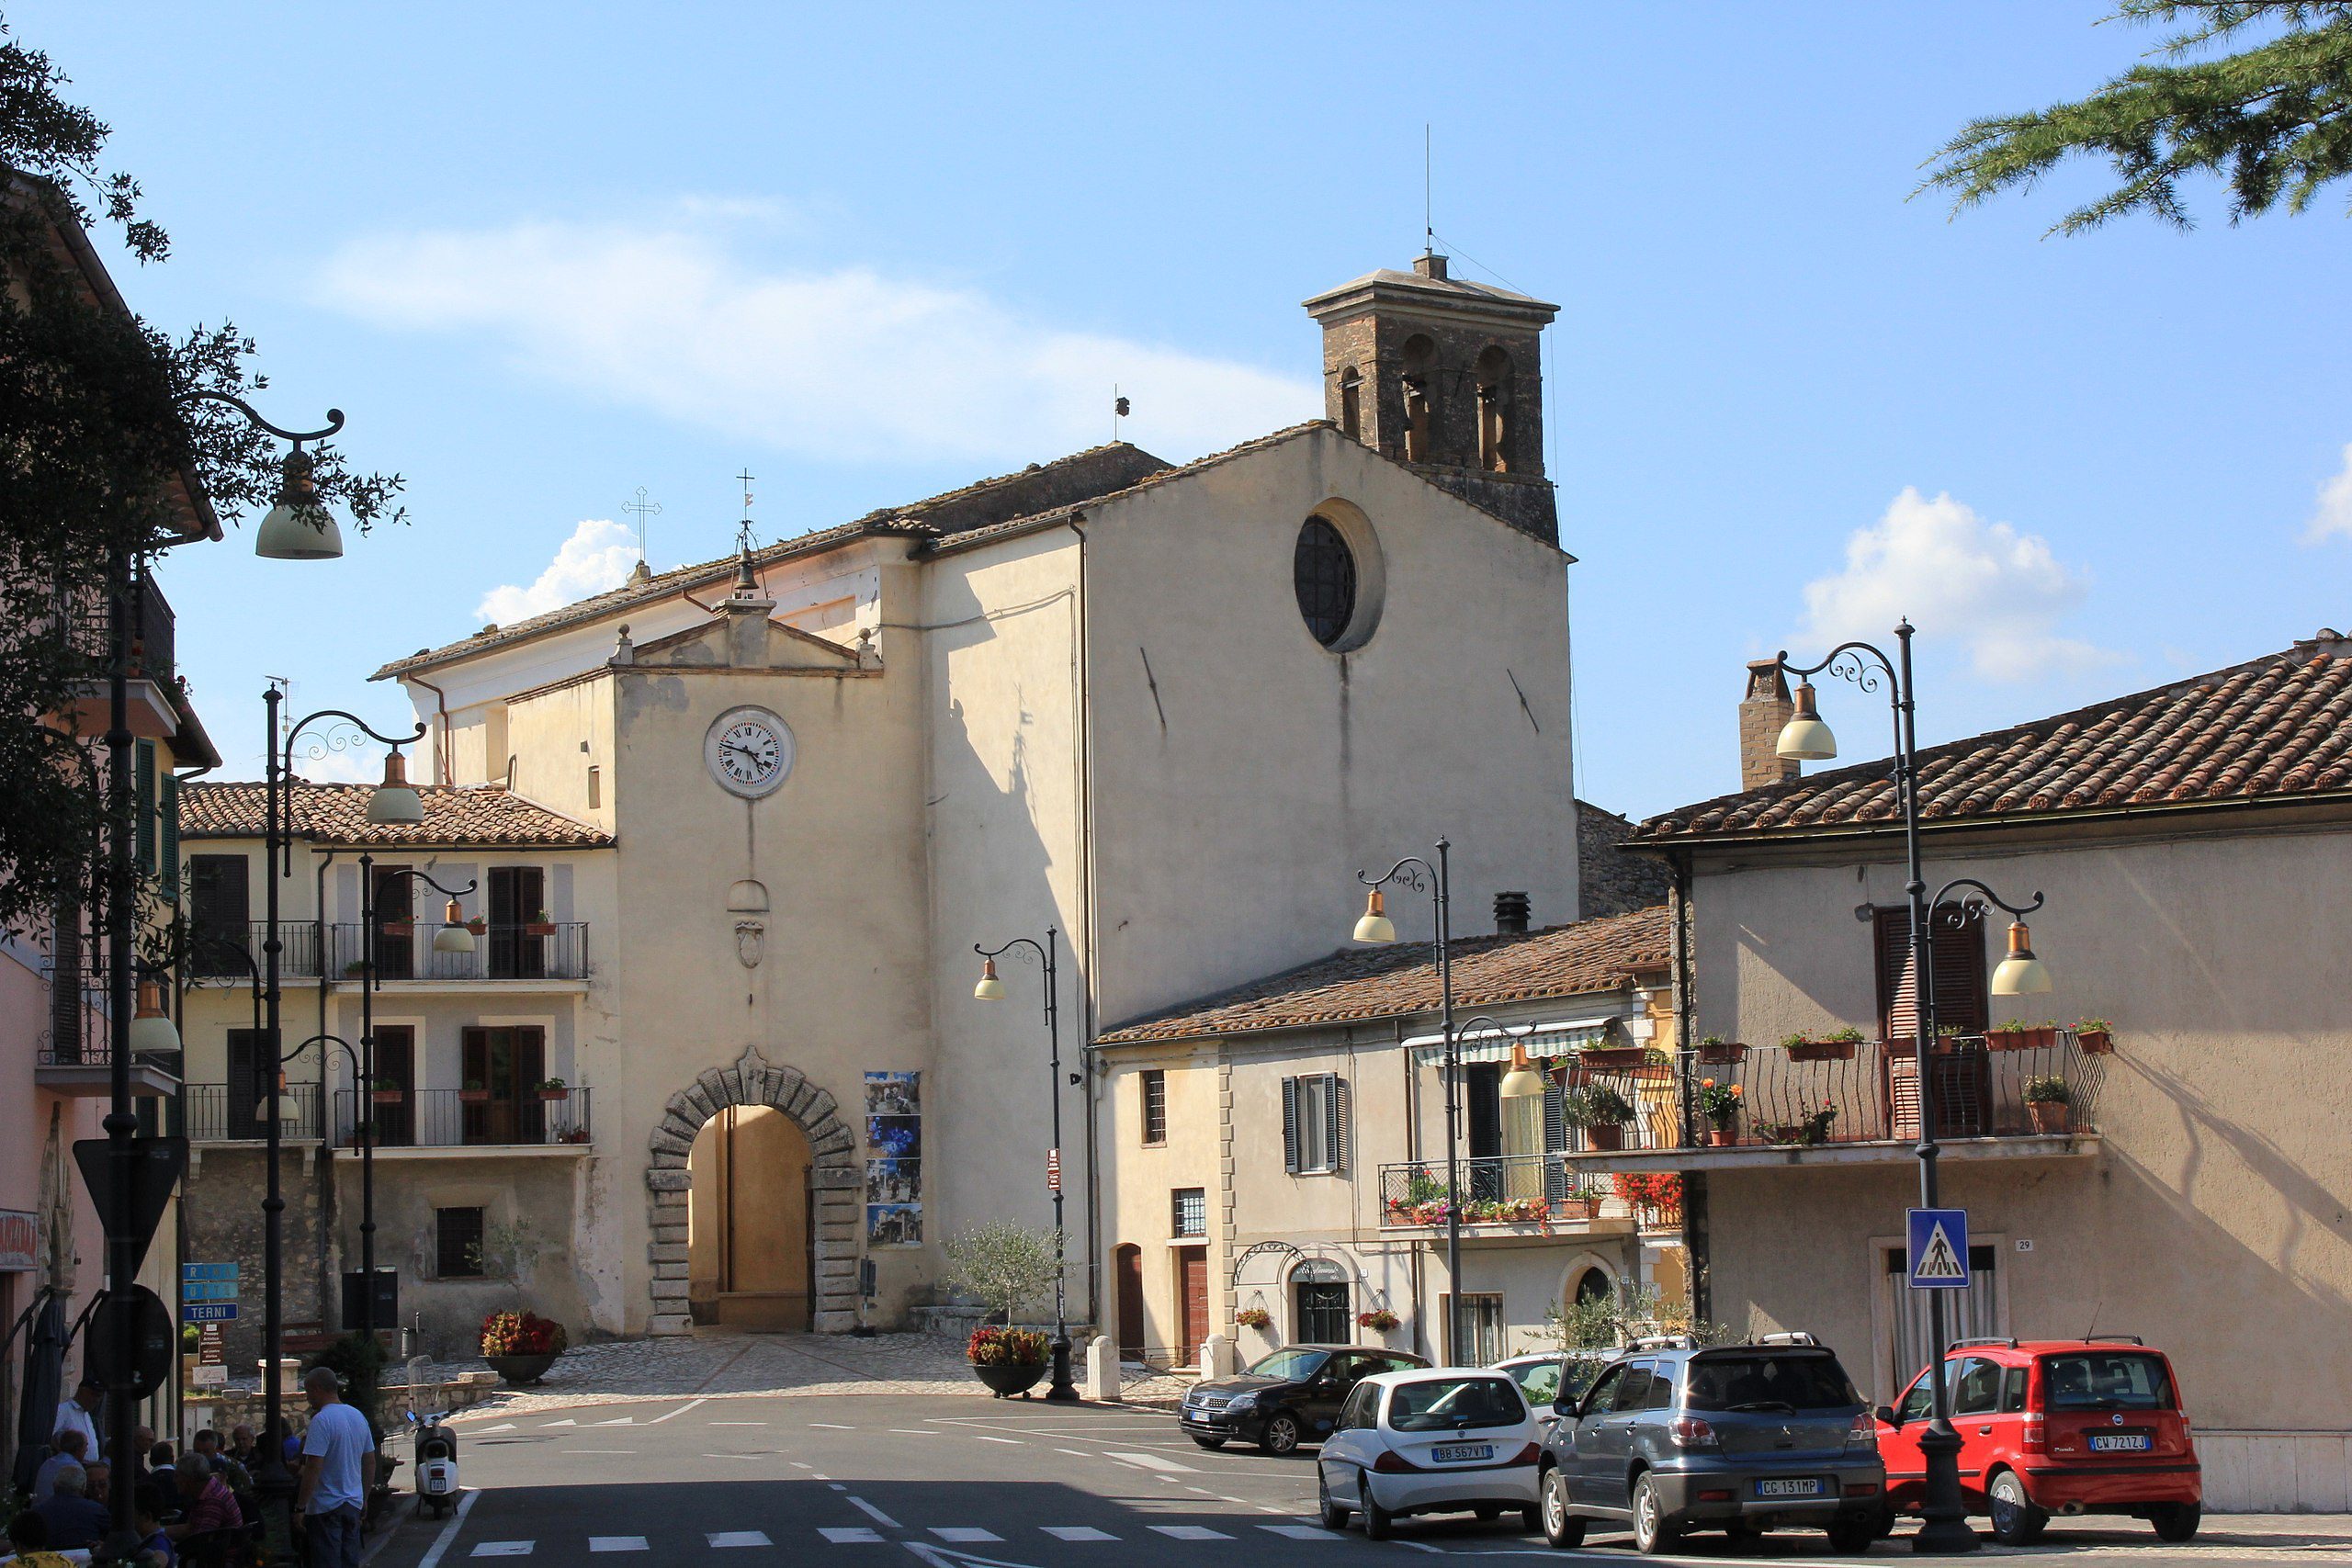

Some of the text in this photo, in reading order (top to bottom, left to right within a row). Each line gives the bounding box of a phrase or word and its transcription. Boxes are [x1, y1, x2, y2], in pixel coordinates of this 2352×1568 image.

[2019, 1241, 2030, 1249] 29
[191, 1306, 226, 1319] TERNI
[2113, 1437, 2145, 1448] 721ZJ
[1440, 1446, 1485, 1459] BB 567VT
[1764, 1481, 1815, 1494] CG 131MP
